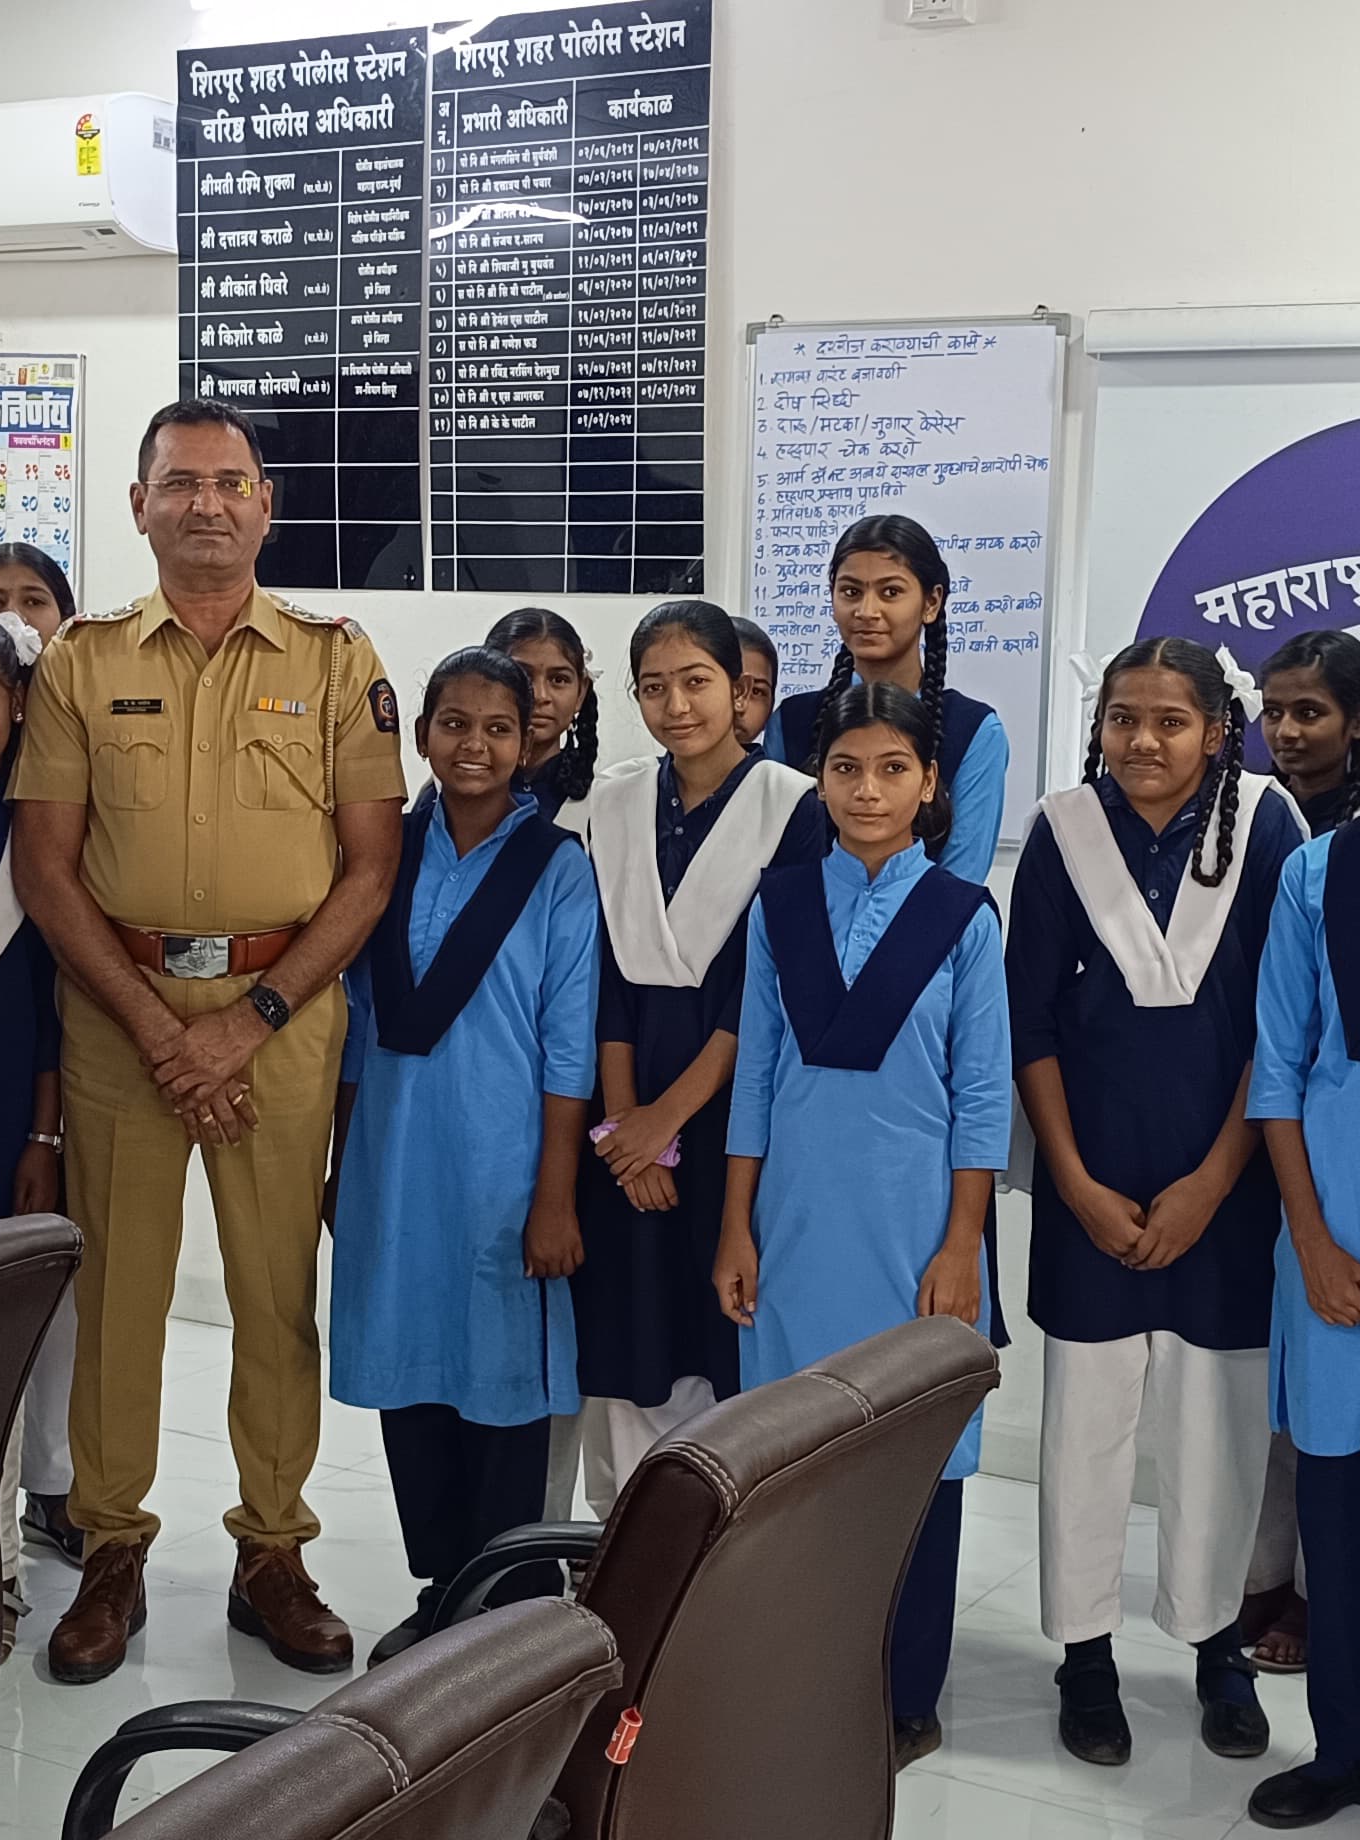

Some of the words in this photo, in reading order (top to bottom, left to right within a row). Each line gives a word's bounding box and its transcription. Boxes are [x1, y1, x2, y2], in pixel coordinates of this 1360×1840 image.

[453, 39, 509, 78] शिरपूर
[514, 35, 554, 67] शहर
[559, 18, 622, 58] पोलीस
[628, 12, 686, 53] स्टेशन
[190, 60, 243, 104] शिरपूर
[248, 63, 286, 94] शहर
[290, 49, 349, 87] पोलीस
[354, 43, 407, 82] स्टेशन
[462, 103, 501, 134] प्रभारी
[506, 97, 568, 129] अधिकारी
[607, 89, 674, 120] कार्यकाळ
[201, 108, 245, 144] वरिष्ठ
[251, 102, 309, 140] पोलीस
[315, 93, 395, 134] अधिकारी
[201, 172, 234, 196] श्रीमती
[263, 172, 295, 199] शुक्ला
[200, 226, 215, 249] श्री
[260, 220, 293, 246] कराळे
[200, 276, 215, 299] श्री
[218, 273, 257, 298] श्रीकांत
[200, 324, 215, 347] श्री
[218, 323, 254, 348] किशोर
[256, 321, 284, 345] काळे
[200, 374, 214, 398] श्री
[217, 375, 256, 396] भागवत
[259, 370, 300, 396] सोनवणे
[880, 437, 921, 459] करणे
[54, 464, 71, 480] २६
[980, 453, 1022, 473] आरोपी
[21, 496, 38, 512] २०
[53, 496, 71, 513] २७
[53, 528, 69, 545] २८
[806, 520, 838, 538] पाहिजे
[1009, 530, 1043, 553] करणे
[778, 642, 813, 656] MDT
[1003, 631, 1039, 656] करावी
